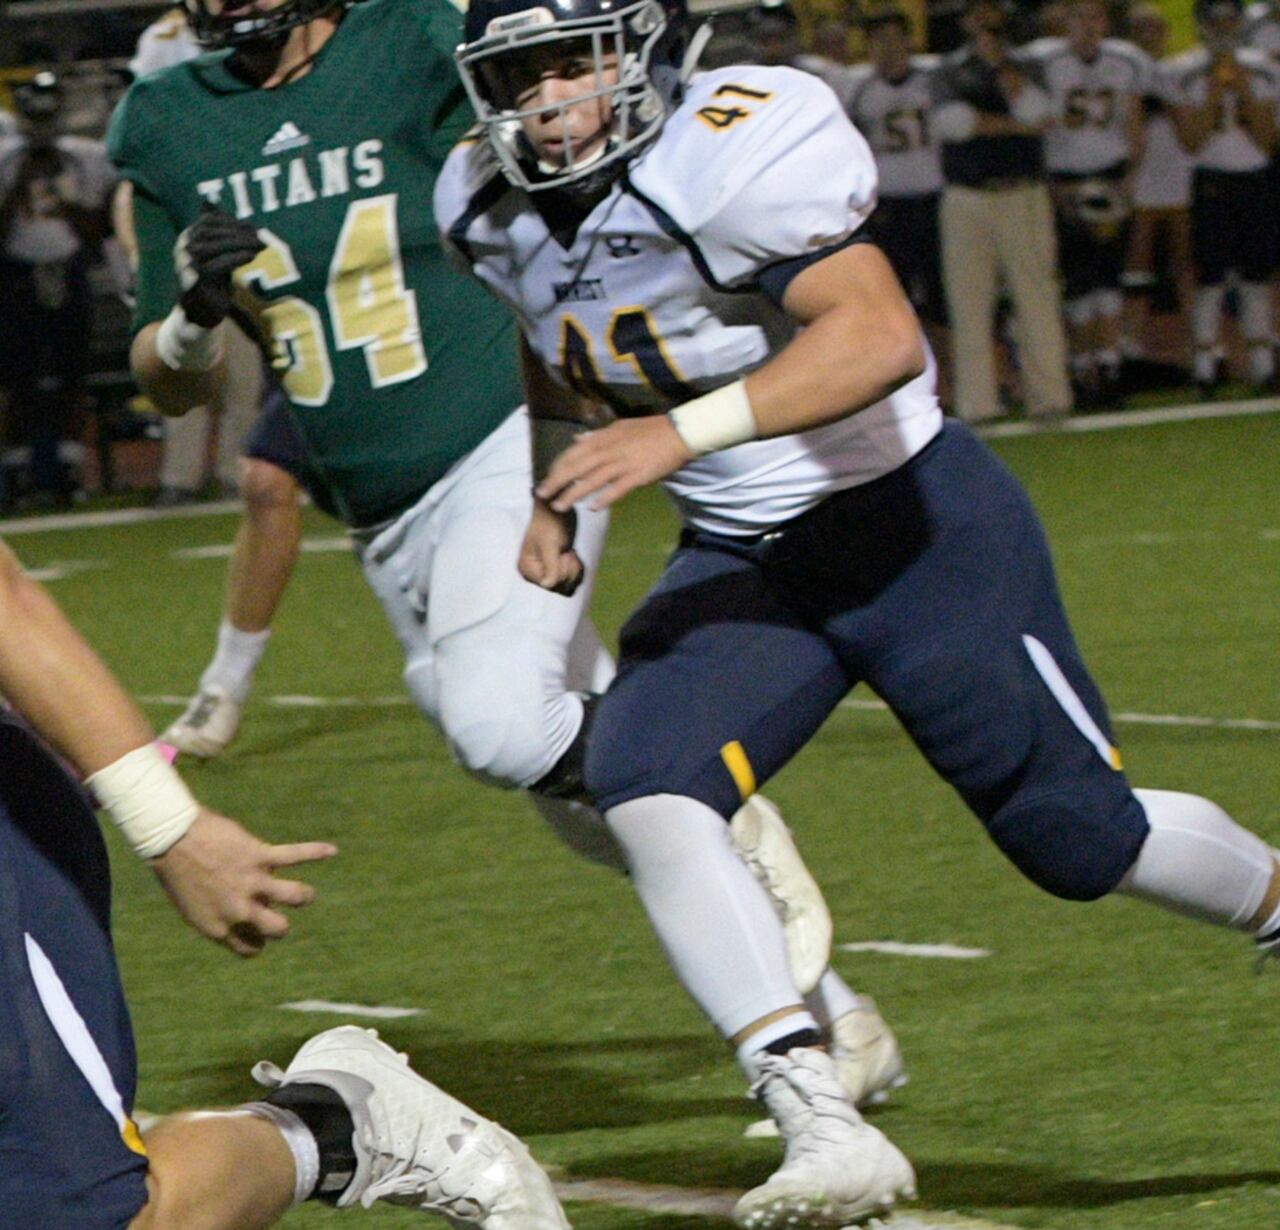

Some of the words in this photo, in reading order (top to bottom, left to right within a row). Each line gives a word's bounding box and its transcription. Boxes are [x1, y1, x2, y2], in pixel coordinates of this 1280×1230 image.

[693, 83, 775, 134] 41
[197, 138, 384, 220] TITANS
[231, 193, 429, 407] 64
